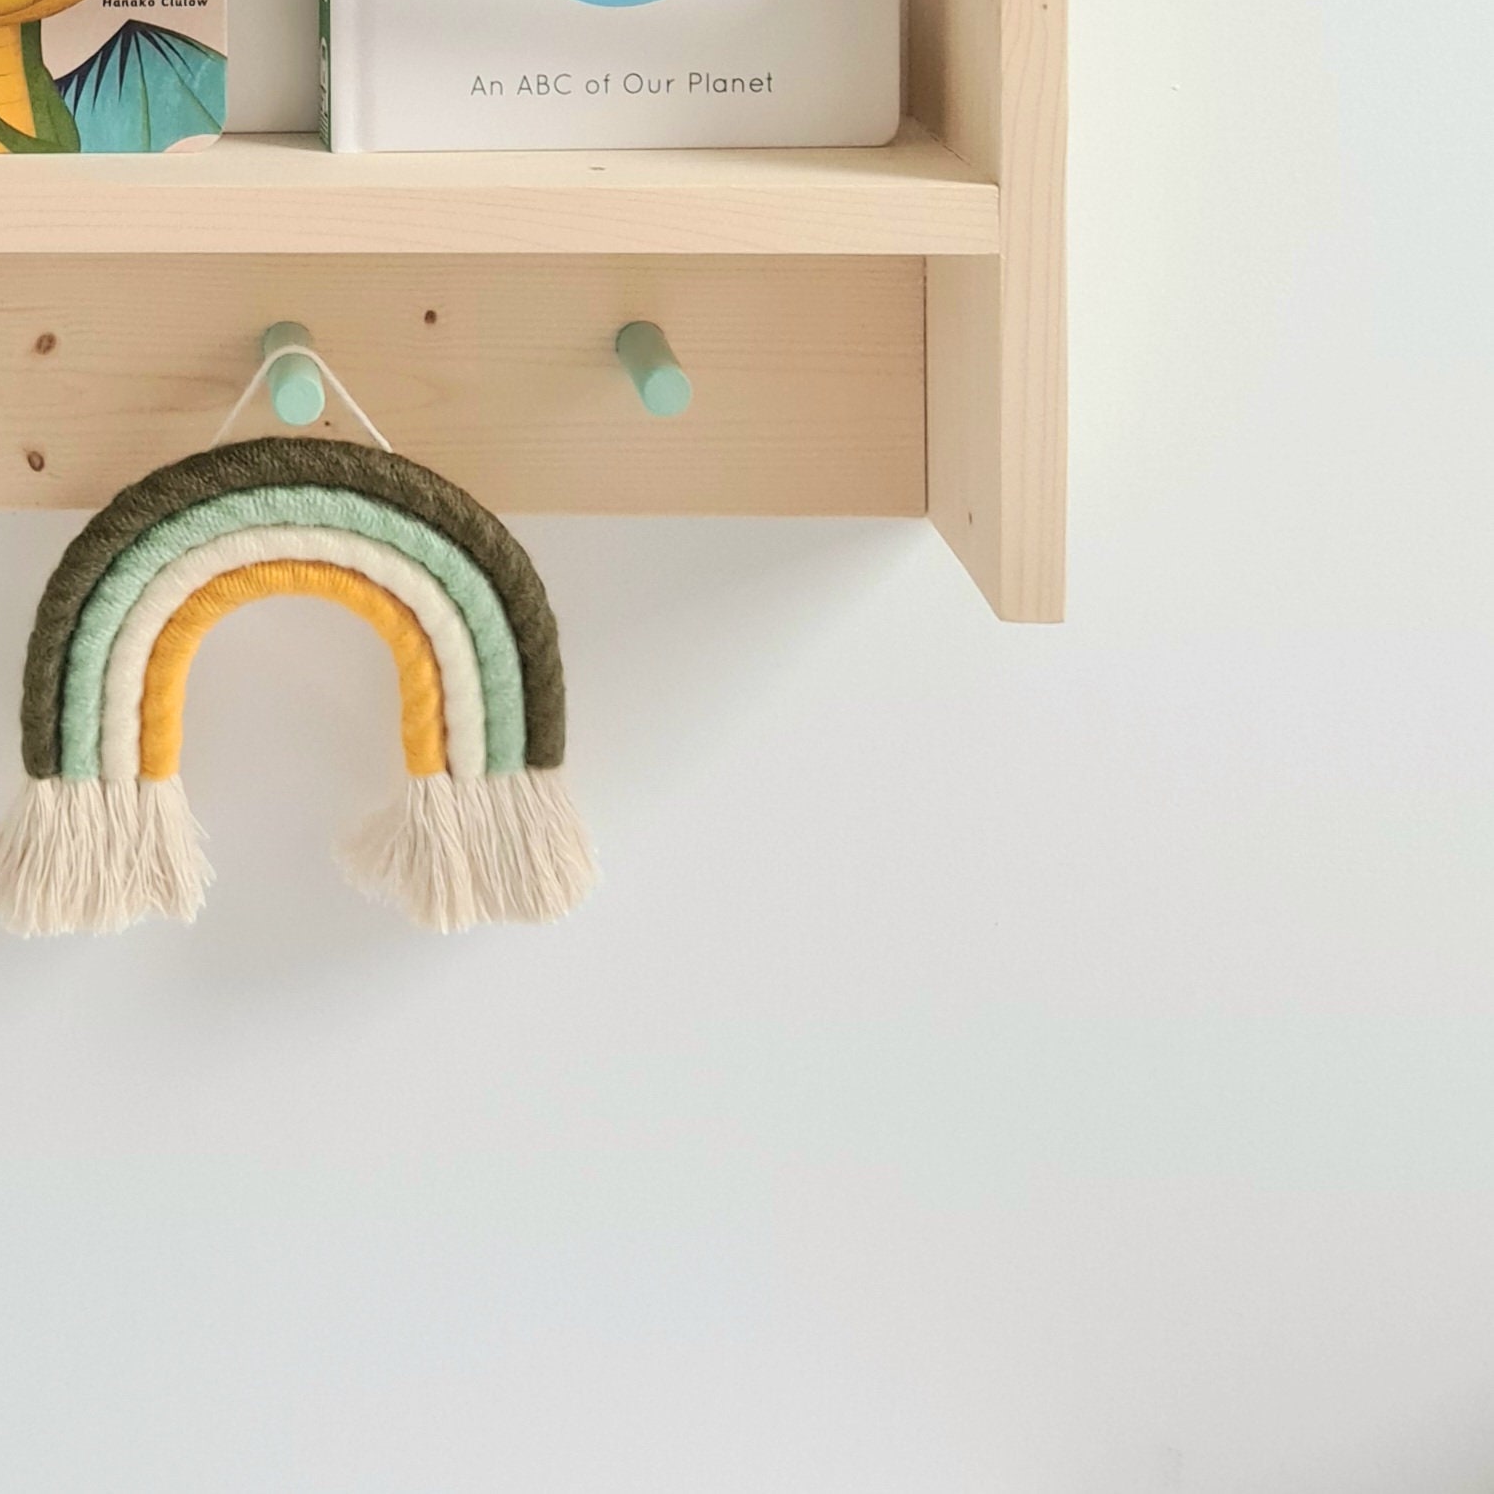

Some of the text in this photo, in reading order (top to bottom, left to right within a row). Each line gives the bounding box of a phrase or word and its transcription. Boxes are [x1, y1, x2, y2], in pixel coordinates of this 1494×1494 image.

[470, 71, 774, 97] An ABC of Our Planet
